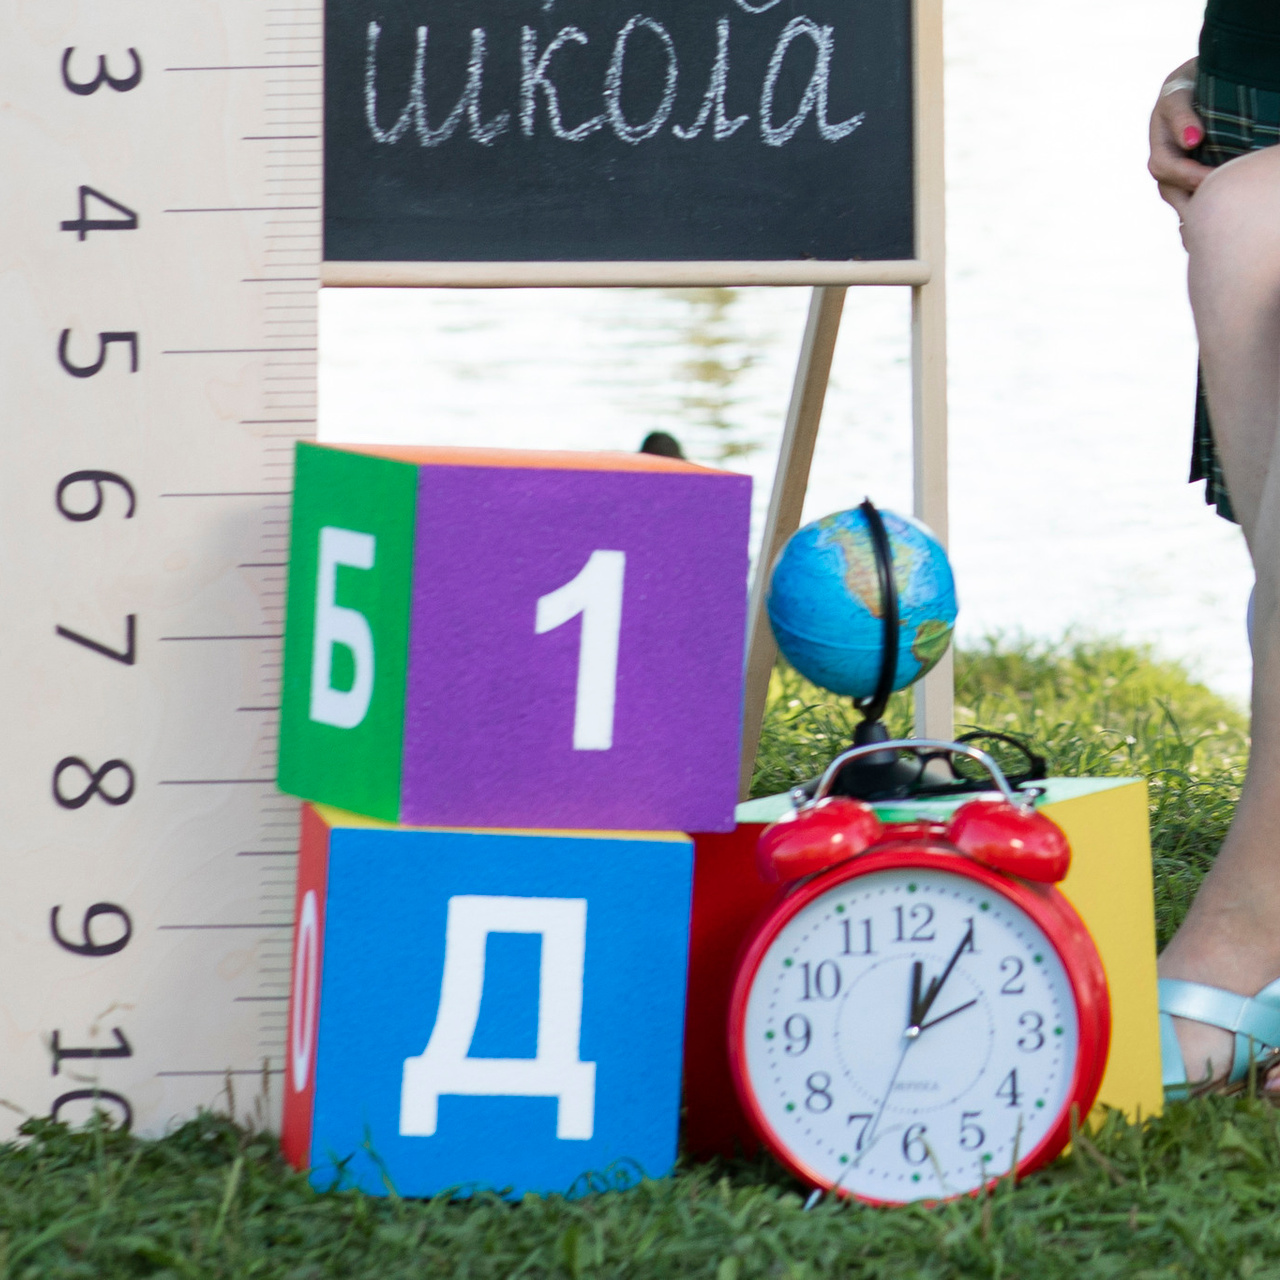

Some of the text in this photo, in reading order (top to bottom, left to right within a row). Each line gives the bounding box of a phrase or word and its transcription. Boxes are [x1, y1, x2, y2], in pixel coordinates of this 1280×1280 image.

[61, 47, 143, 96] 3
[60, 185, 139, 241] 4
[58, 328, 139, 378] 5
[56, 469, 136, 522] 6
[56, 613, 136, 666] 7
[309, 526, 376, 729] Б
[534, 550, 626, 751] 1
[52, 756, 136, 809] 8
[50, 902, 134, 957] 9
[841, 918, 878, 956] 11
[893, 903, 937, 943] 12
[800, 960, 842, 1001] 10
[1000, 956, 1025, 995] 2
[399, 894, 597, 1140] Д
[784, 1014, 812, 1056] 9
[1017, 1012, 1045, 1052] 3
[805, 1071, 833, 1113] 8
[995, 1068, 1023, 1107] 4
[847, 1113, 875, 1153] 7
[902, 1122, 930, 1164] 6
[958, 1111, 986, 1151] 5
